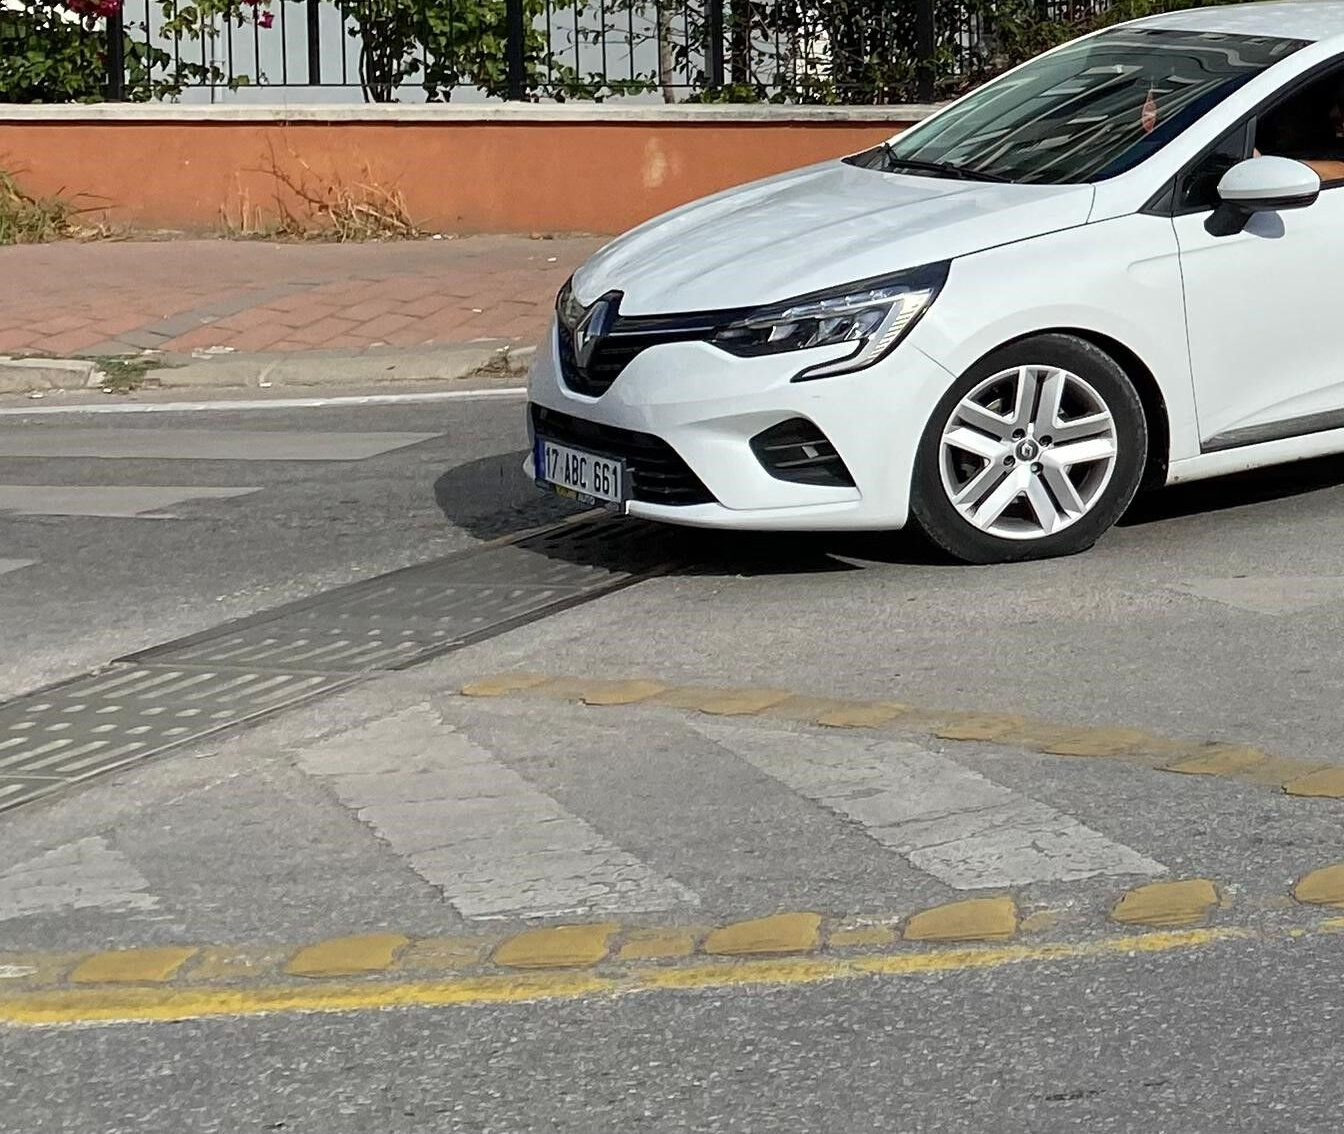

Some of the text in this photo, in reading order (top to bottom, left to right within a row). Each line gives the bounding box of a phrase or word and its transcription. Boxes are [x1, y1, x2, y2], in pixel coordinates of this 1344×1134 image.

[546, 447, 618, 498] 17 ABC 661
